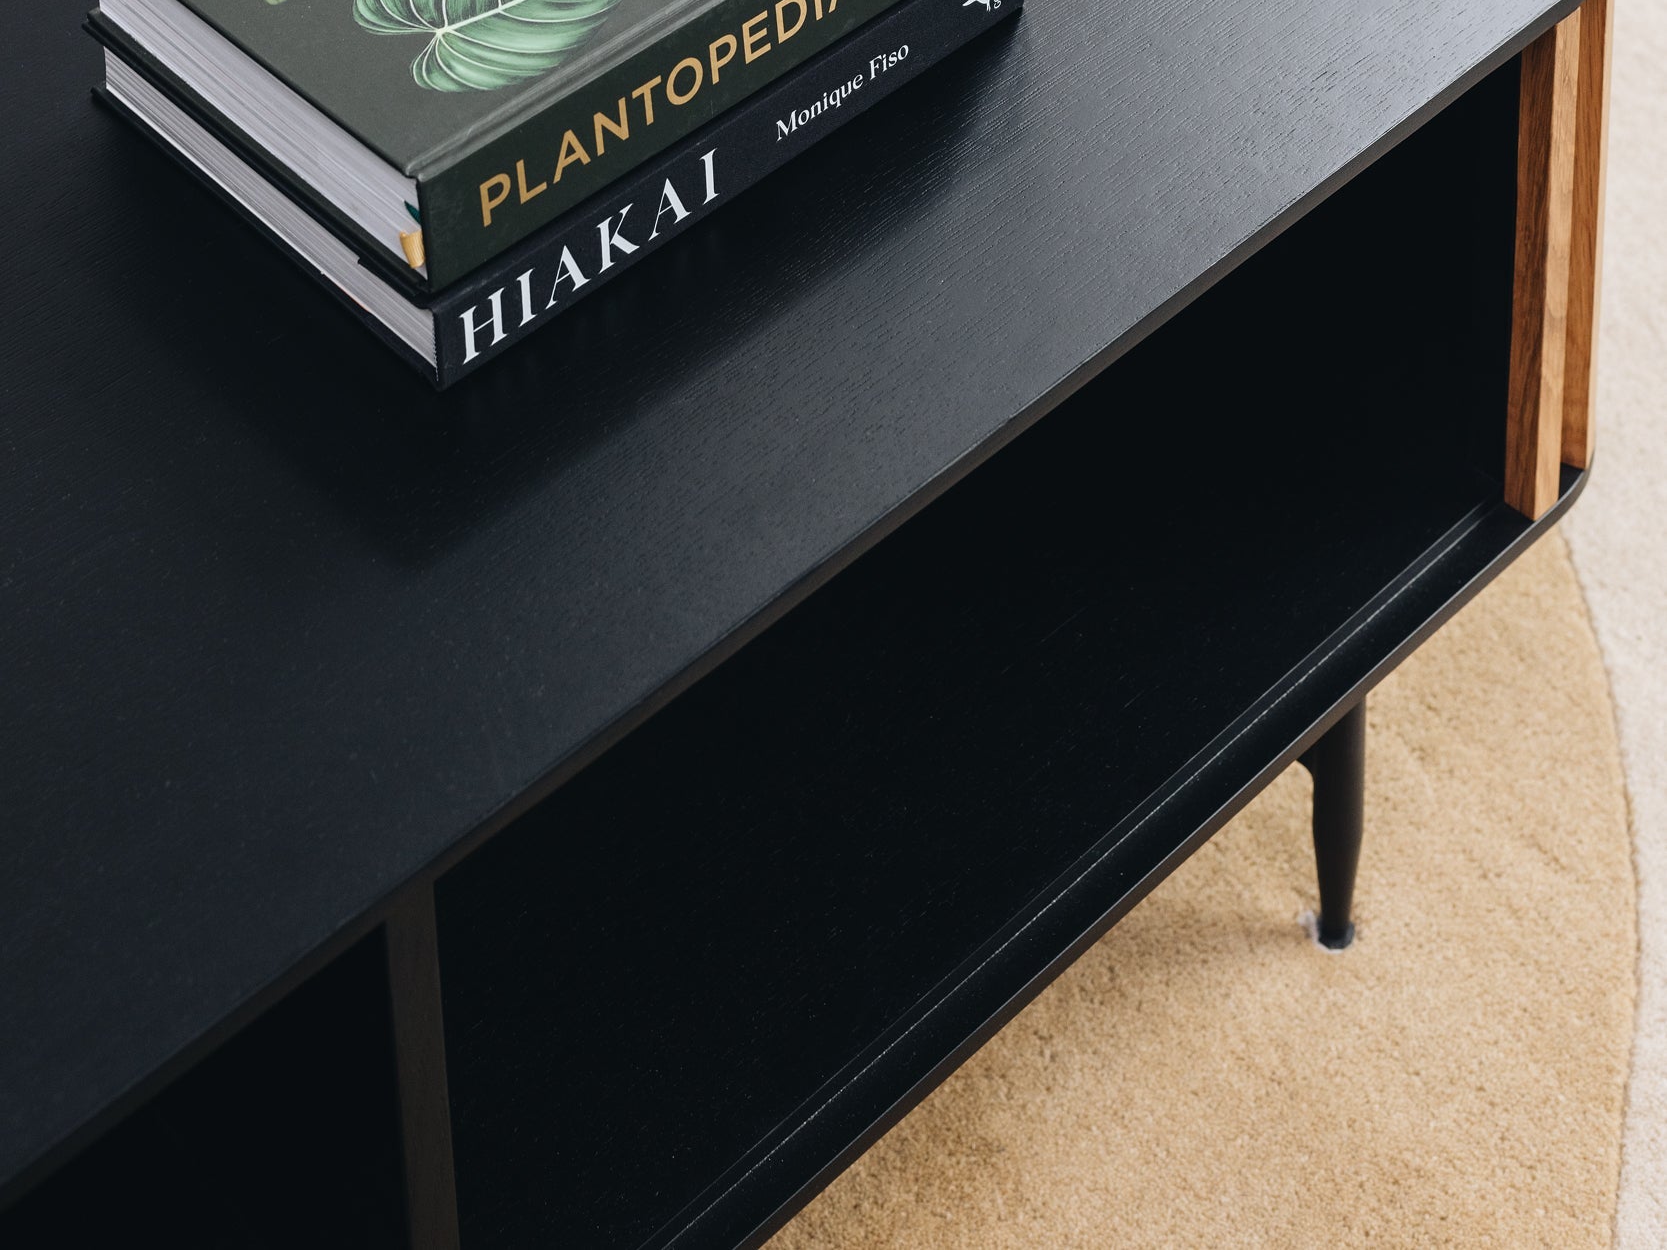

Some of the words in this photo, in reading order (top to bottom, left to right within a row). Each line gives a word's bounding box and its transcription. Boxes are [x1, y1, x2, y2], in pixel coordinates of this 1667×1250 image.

[775, 73, 864, 142] Monique
[868, 44, 910, 81] Fiso
[458, 148, 720, 365] HIAKAI
